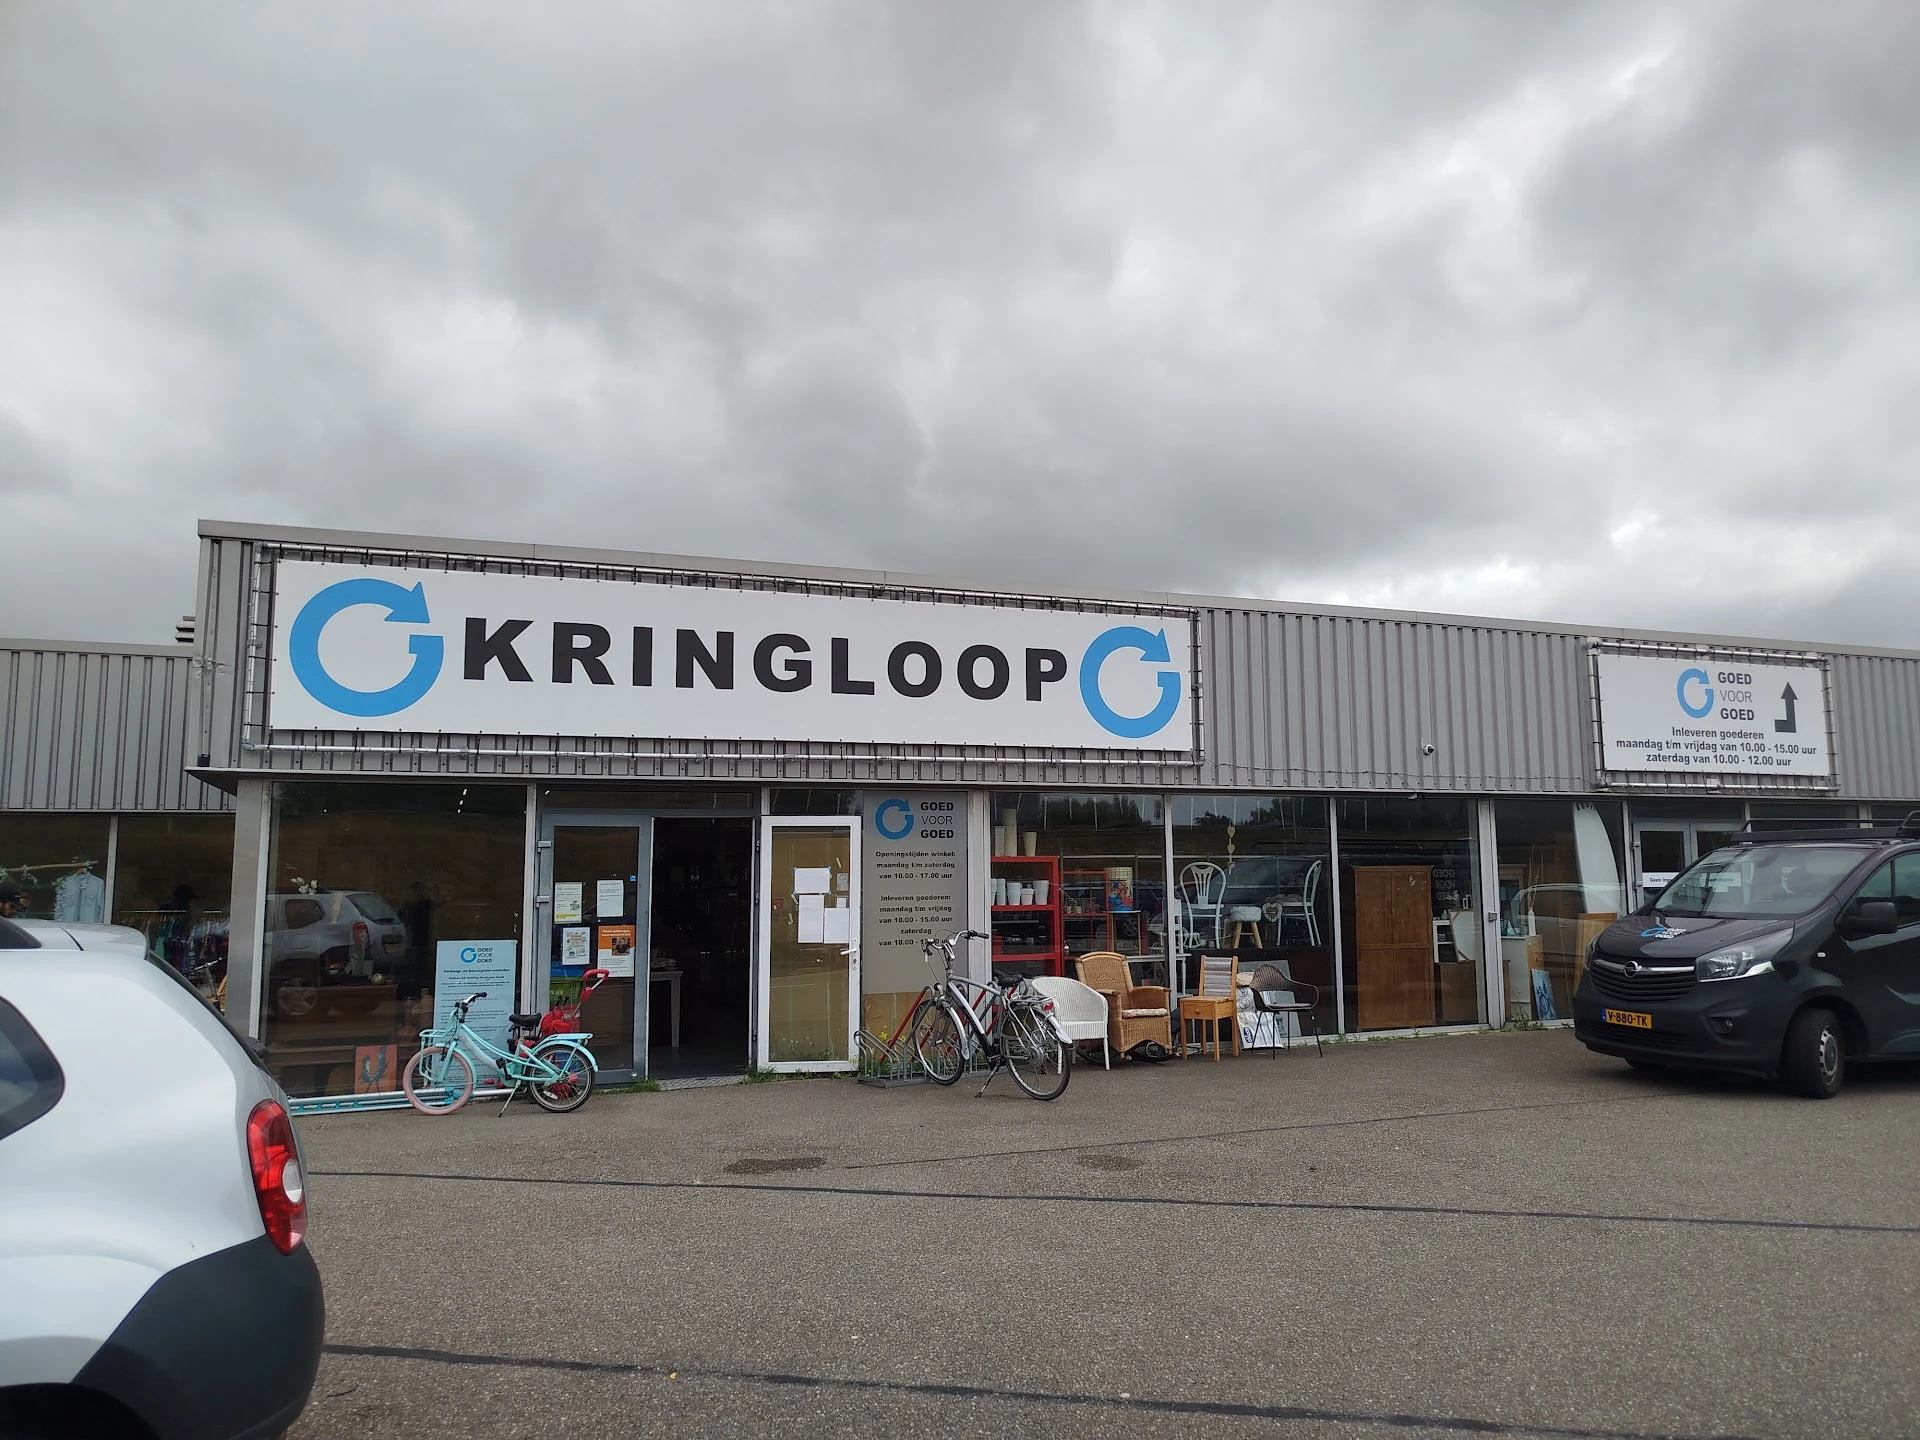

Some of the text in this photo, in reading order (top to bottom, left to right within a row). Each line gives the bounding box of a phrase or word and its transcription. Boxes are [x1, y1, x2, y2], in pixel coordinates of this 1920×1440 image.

[463, 616, 1067, 702] KRINGLOOP
[1717, 671, 1753, 686] GOED
[1719, 689, 1753, 703] VOOR
[1720, 707, 1755, 721] GOED
[1672, 726, 1764, 741] Inleveren goederen
[1616, 738, 1663, 751] maandag
[1665, 739, 1681, 750] t/m
[1684, 740, 1717, 753] vrijdag
[1720, 743, 1737, 752] van
[1740, 742, 1766, 753] 10.00
[1774, 744, 1799, 754] 15.00
[1802, 747, 1817, 755] uur
[1646, 752, 1690, 765] zaterdag
[1693, 755, 1711, 764] van
[1713, 754, 1740, 764] 10.00
[1748, 755, 1774, 766] 12.00
[1776, 758, 1791, 766] uur
[920, 801, 954, 811] GOED
[921, 815, 954, 825] VOOR
[920, 829, 954, 839] GOED
[875, 850, 929, 859] Openingstijden
[876, 861, 909, 869] maandag
[924, 861, 955, 869] zaterdag
[879, 906, 913, 914] maandag
[927, 905, 952, 913] vrijdag
[900, 927, 932, 935] zaterdag
[1607, 1010, 1648, 1027] V-880-TK
